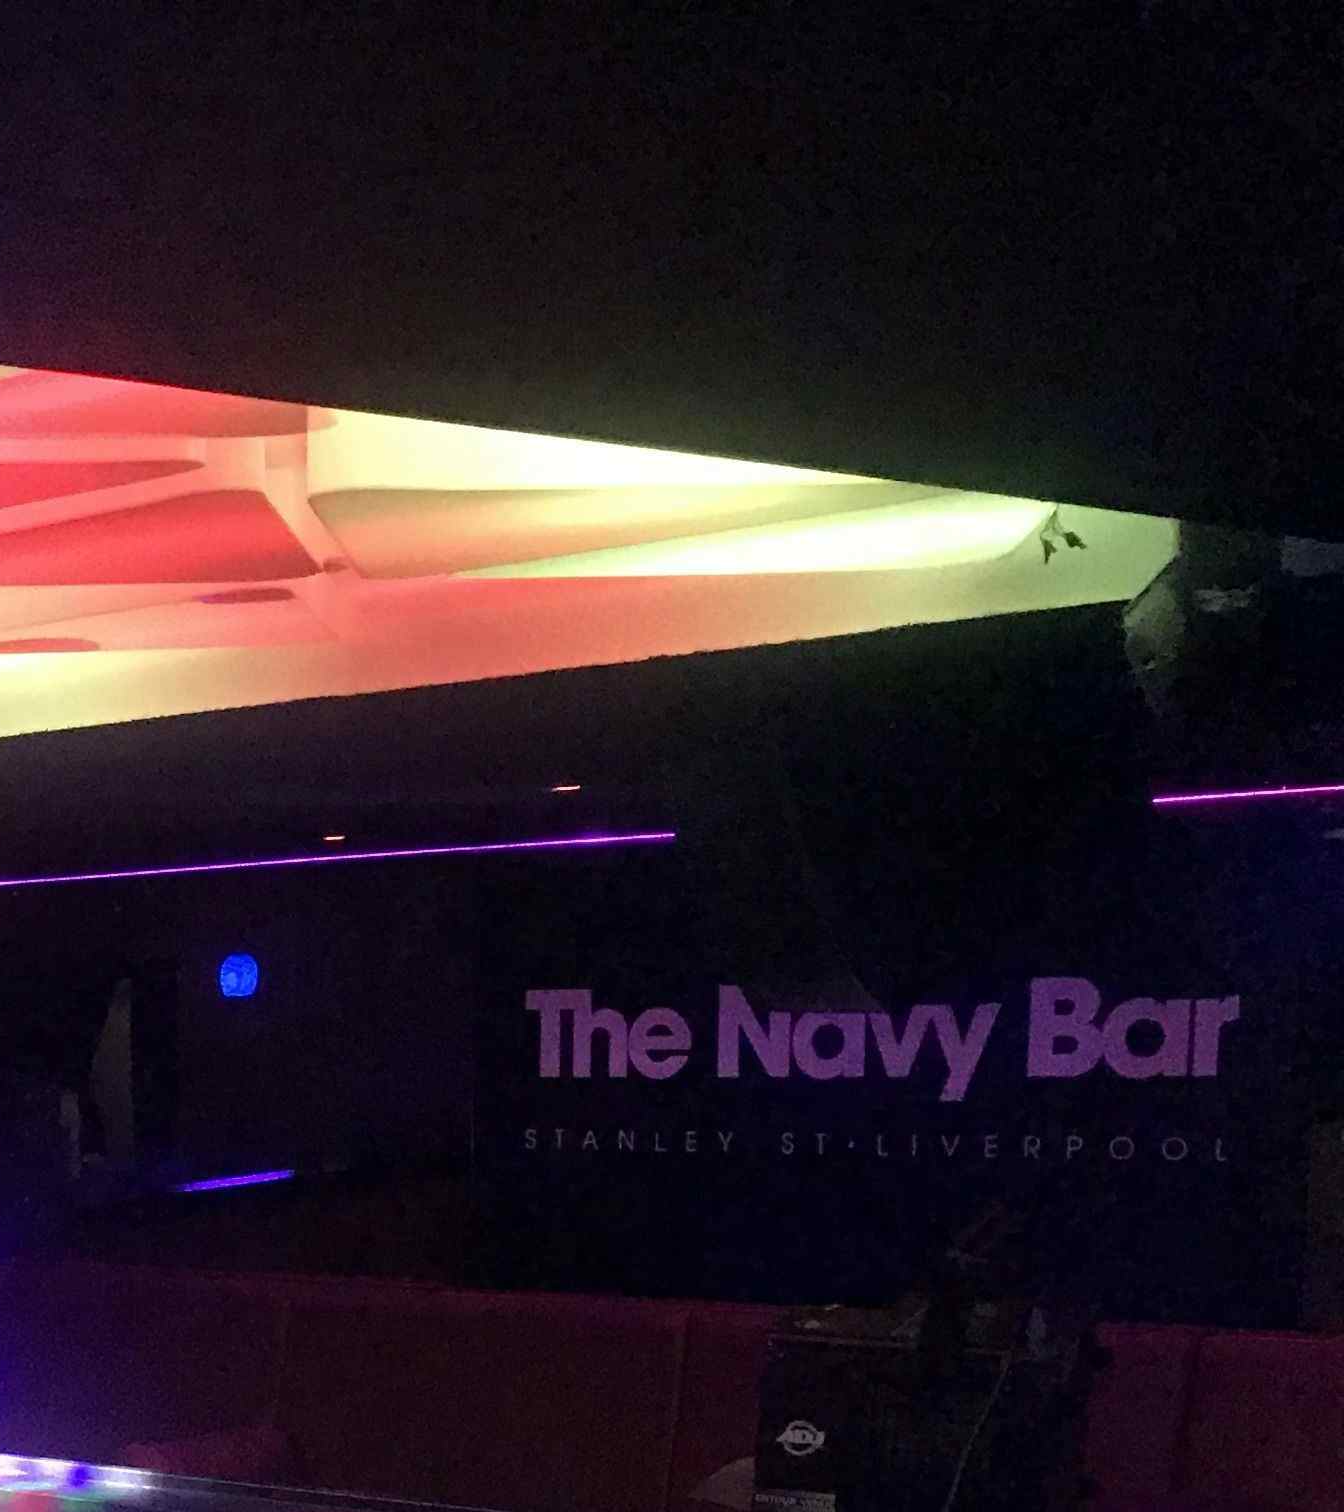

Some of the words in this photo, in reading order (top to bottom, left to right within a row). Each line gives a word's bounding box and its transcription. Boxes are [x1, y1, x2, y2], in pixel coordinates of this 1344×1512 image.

[525, 987, 694, 1080] The
[715, 983, 1002, 1103] Navy
[1023, 976, 1241, 1081] Bar
[523, 1127, 735, 1152] STANLEY
